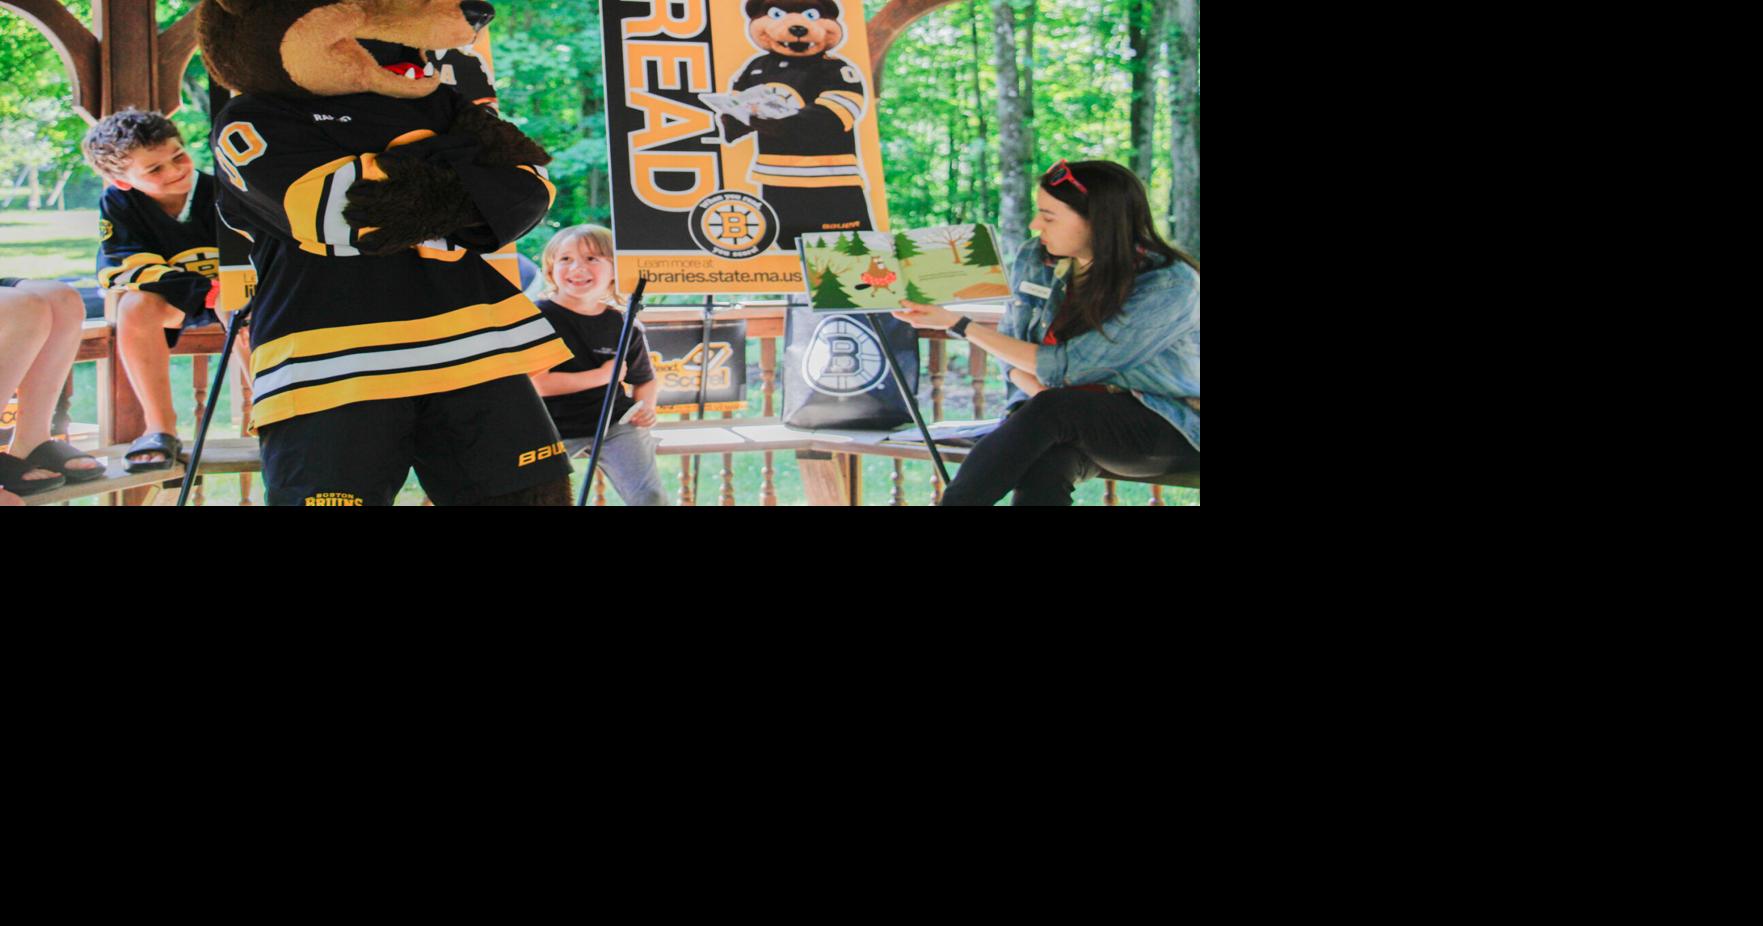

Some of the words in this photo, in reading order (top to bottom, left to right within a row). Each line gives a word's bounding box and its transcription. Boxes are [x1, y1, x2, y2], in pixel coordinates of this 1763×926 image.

[620, 0, 719, 213] READ
[719, 212, 749, 239] B
[637, 258, 669, 268] Learn
[671, 260, 702, 268] more
[703, 259, 713, 268] at
[638, 269, 803, 283] libraries.state.ma.us
[664, 369, 727, 388] Scoe!
[518, 441, 567, 467] BAU
